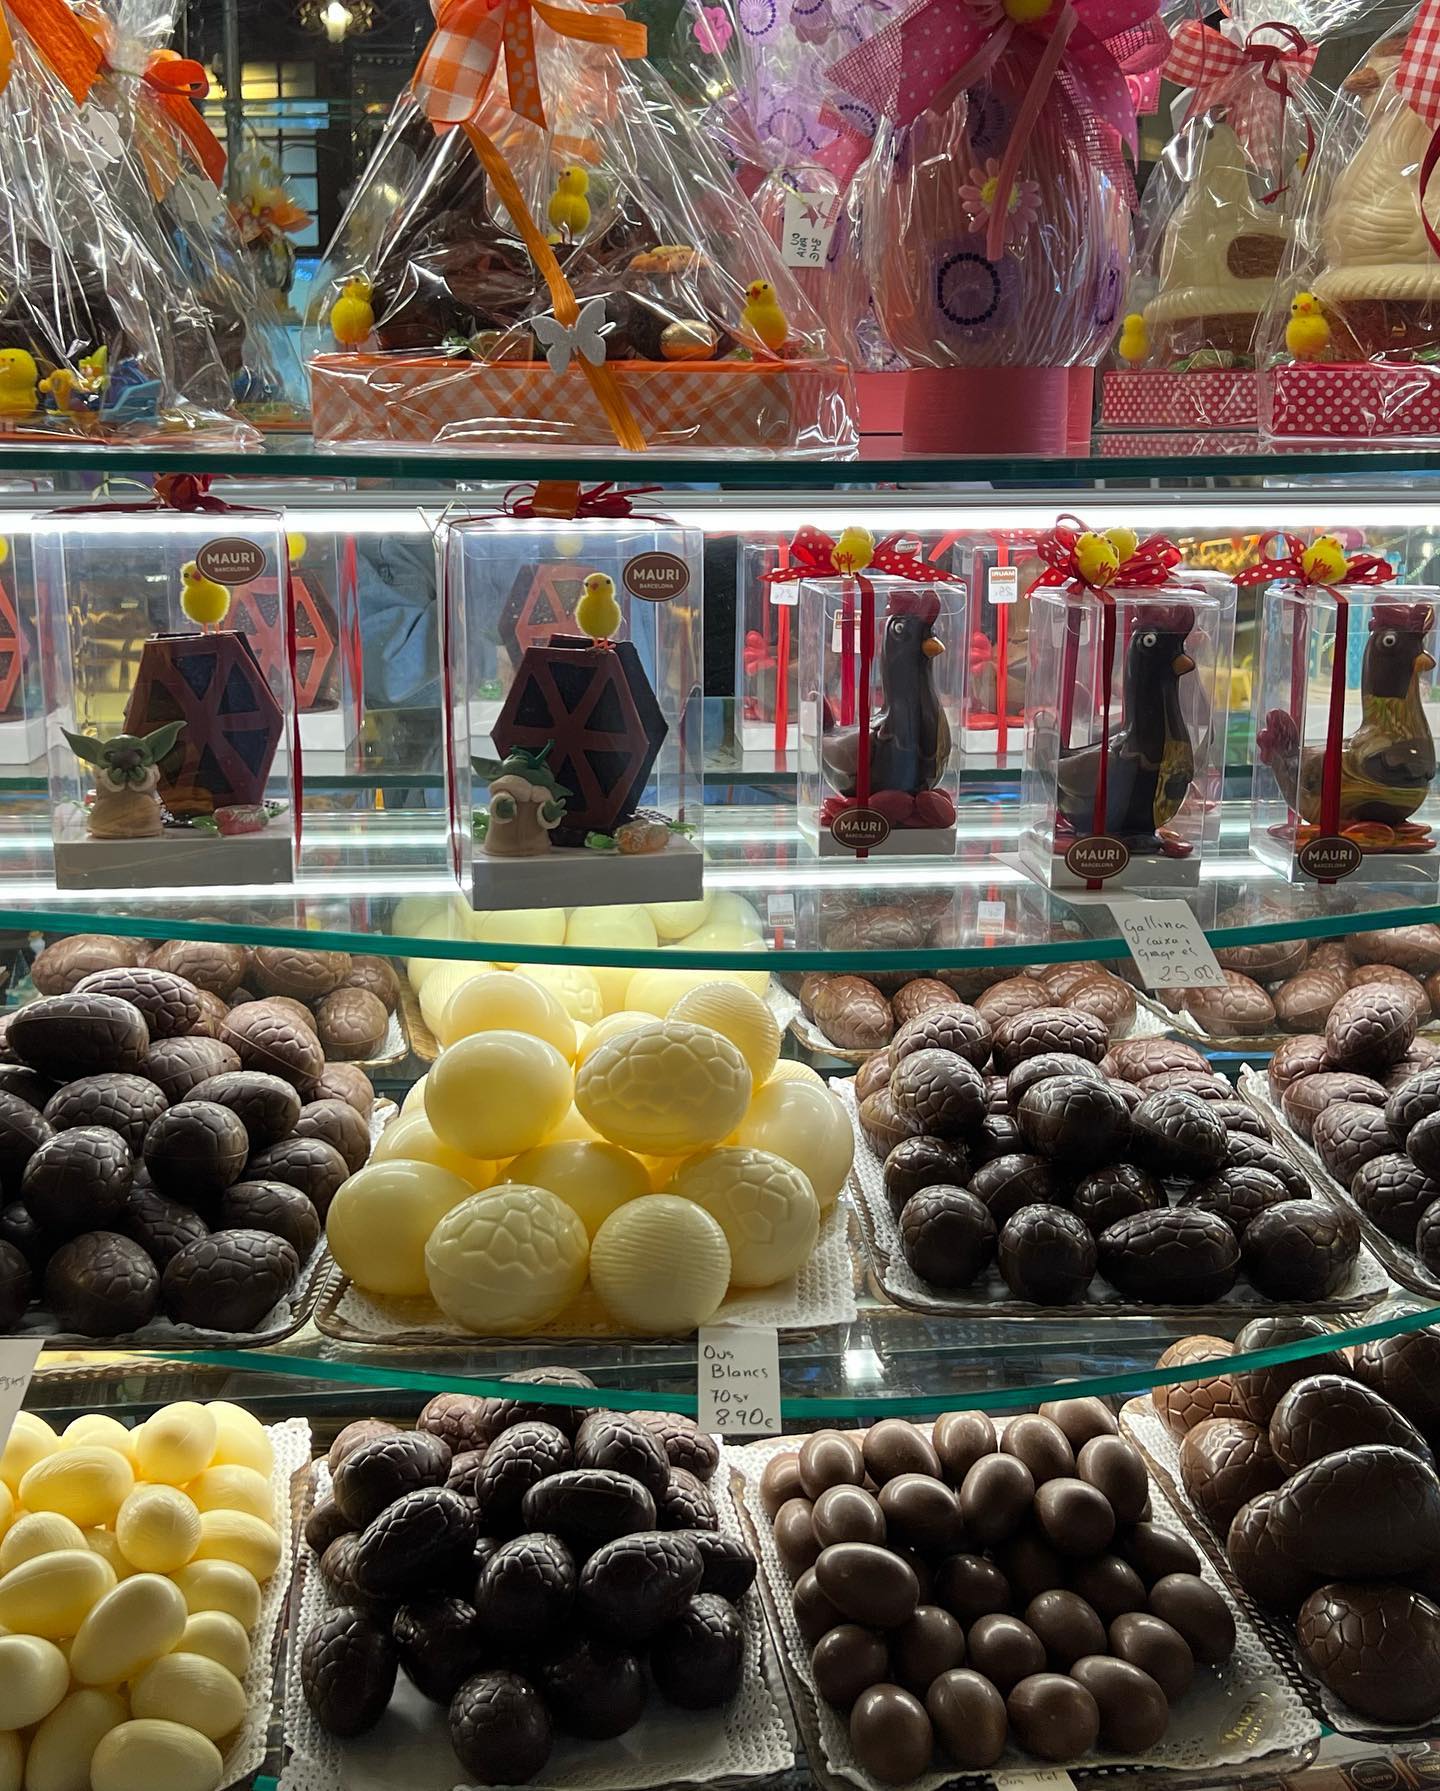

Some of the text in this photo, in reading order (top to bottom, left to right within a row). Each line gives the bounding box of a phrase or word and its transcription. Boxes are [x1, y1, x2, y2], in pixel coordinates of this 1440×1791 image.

[206, 552, 255, 565] MAURI
[633, 568, 680, 580] MAURI
[840, 820, 881, 832] MAURI
[1075, 849, 1120, 861] MAURI
[1308, 849, 1353, 861] MAURI
[1124, 915, 1189, 945] Gallina
[703, 1344, 735, 1360] Ous
[711, 1363, 769, 1379] Blancs
